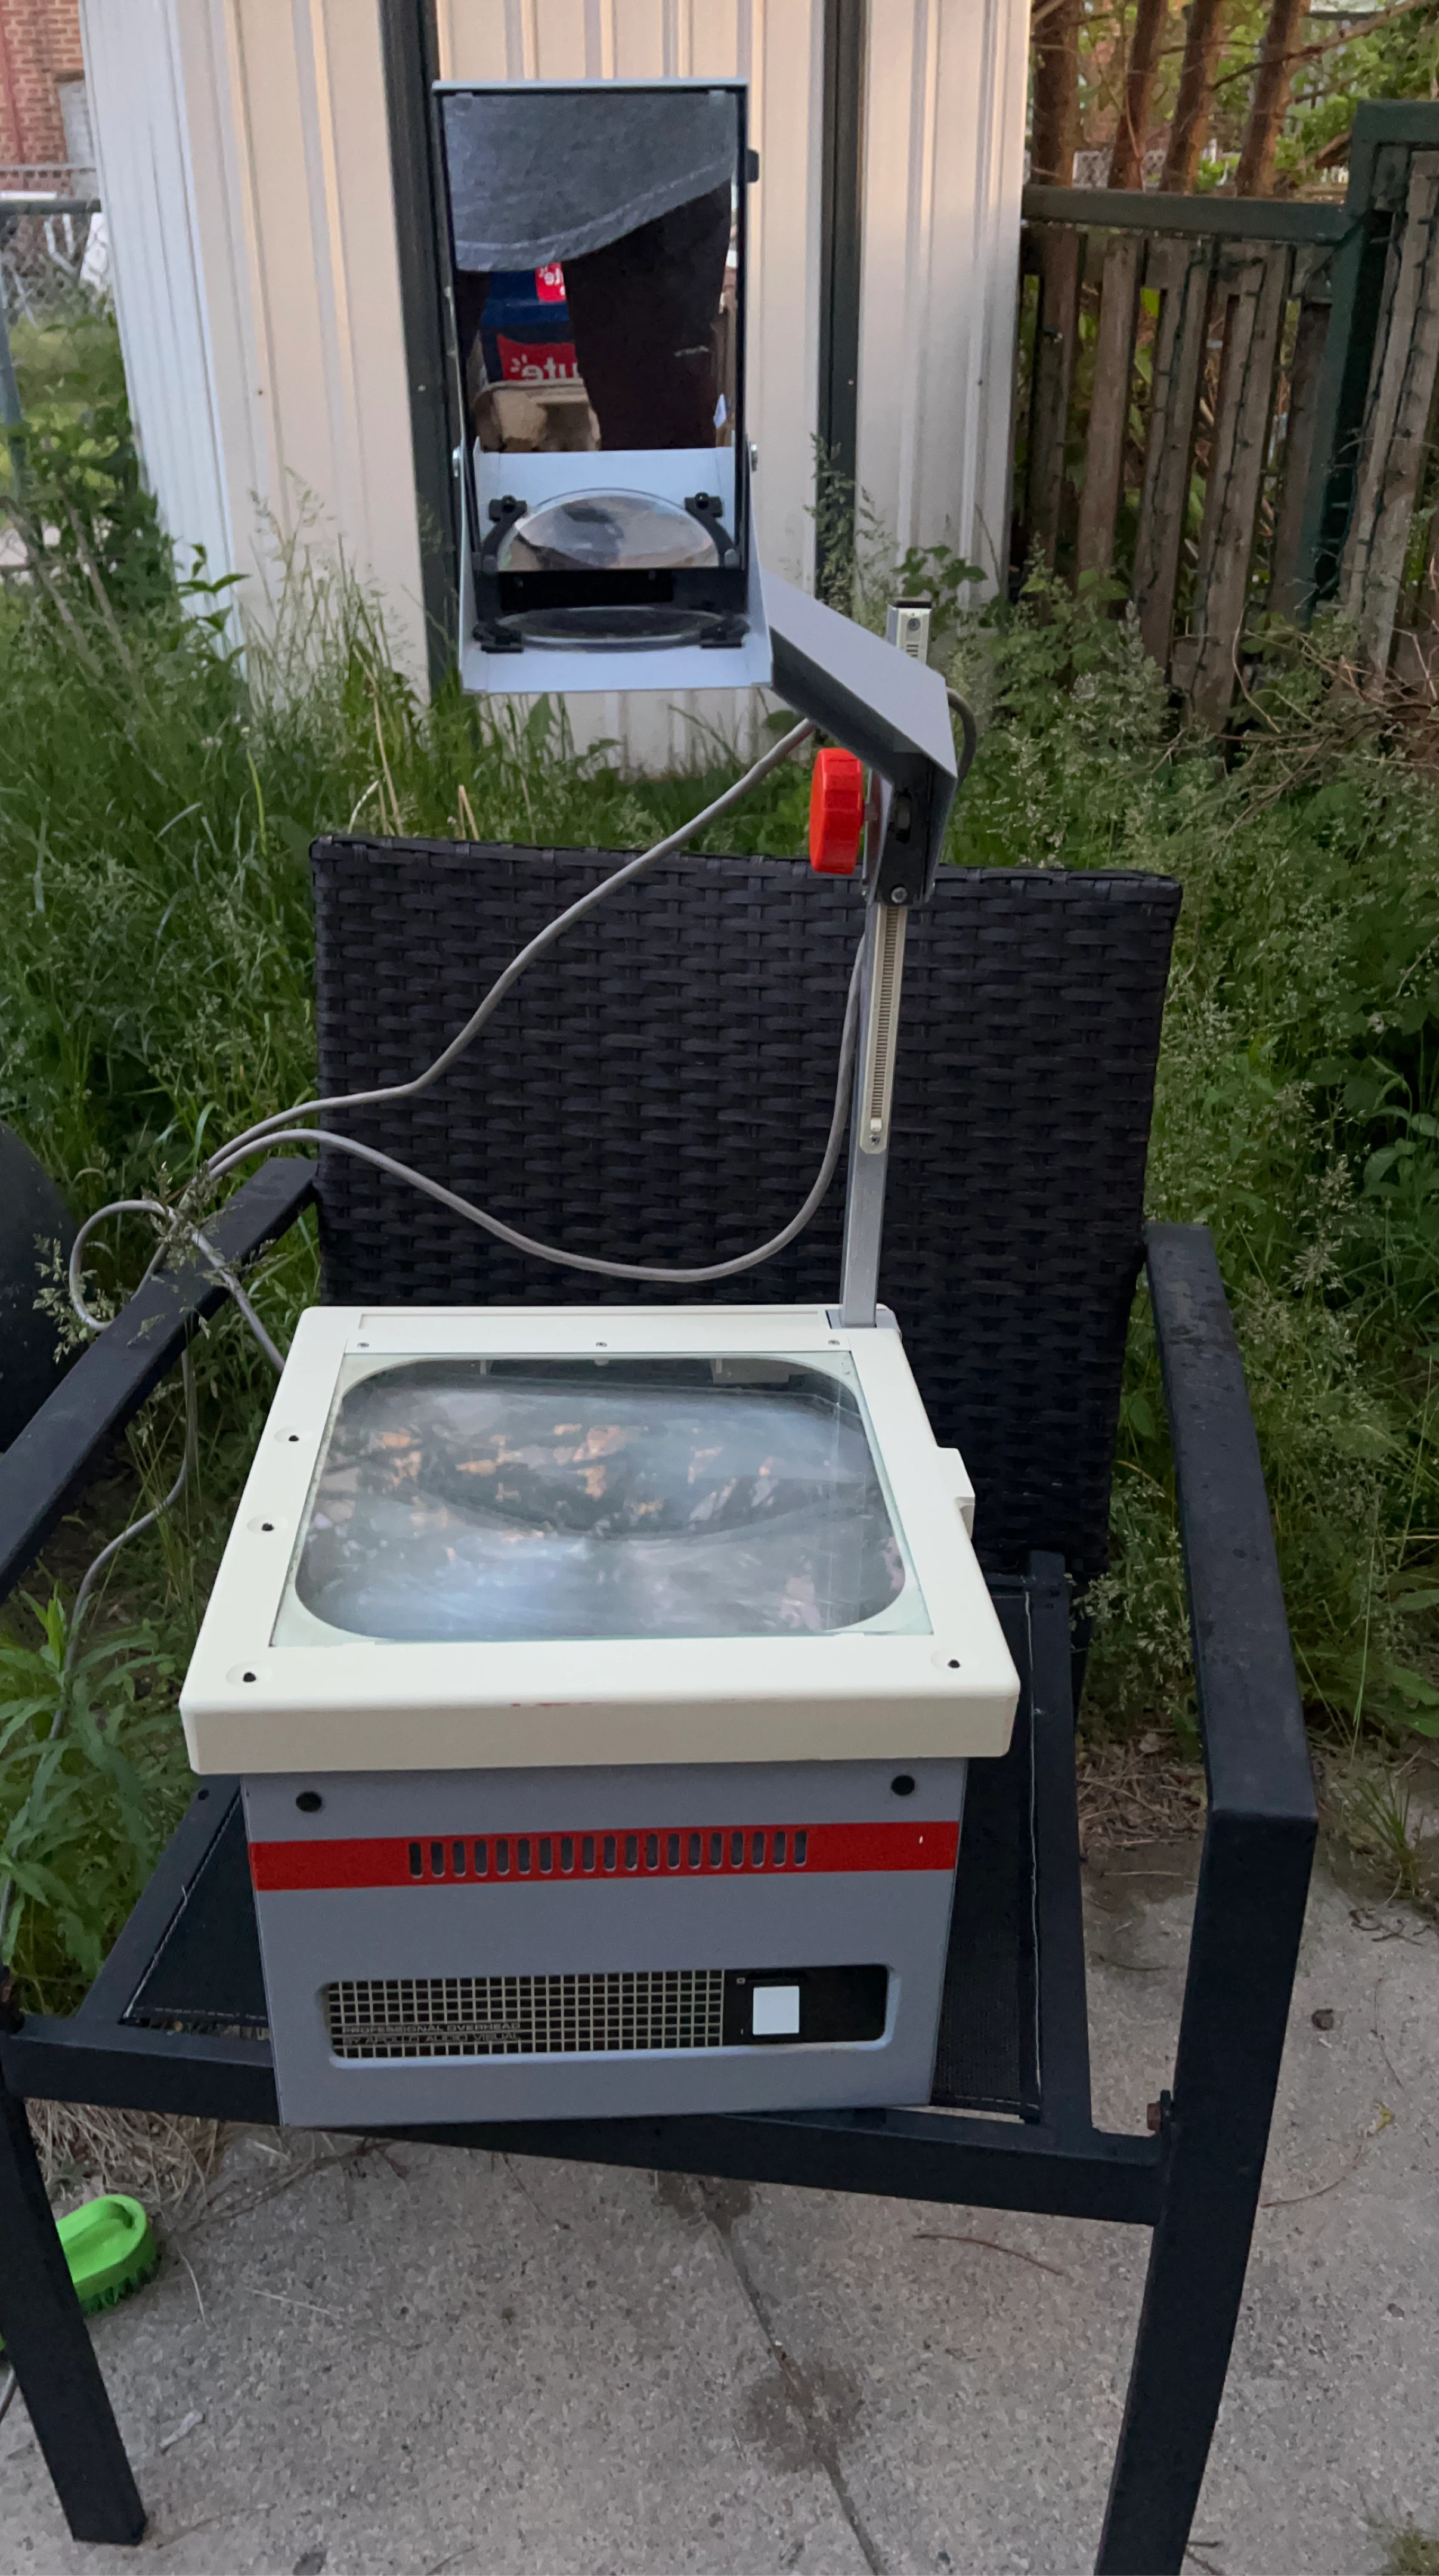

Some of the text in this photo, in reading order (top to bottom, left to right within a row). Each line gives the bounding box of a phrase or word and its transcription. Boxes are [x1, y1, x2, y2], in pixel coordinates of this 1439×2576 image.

[342, 2023, 521, 2034] PROFESSIONAL OVERHEAD
[425, 2033, 468, 2042] AUDIO
[474, 2032, 520, 2041] VISUAL
